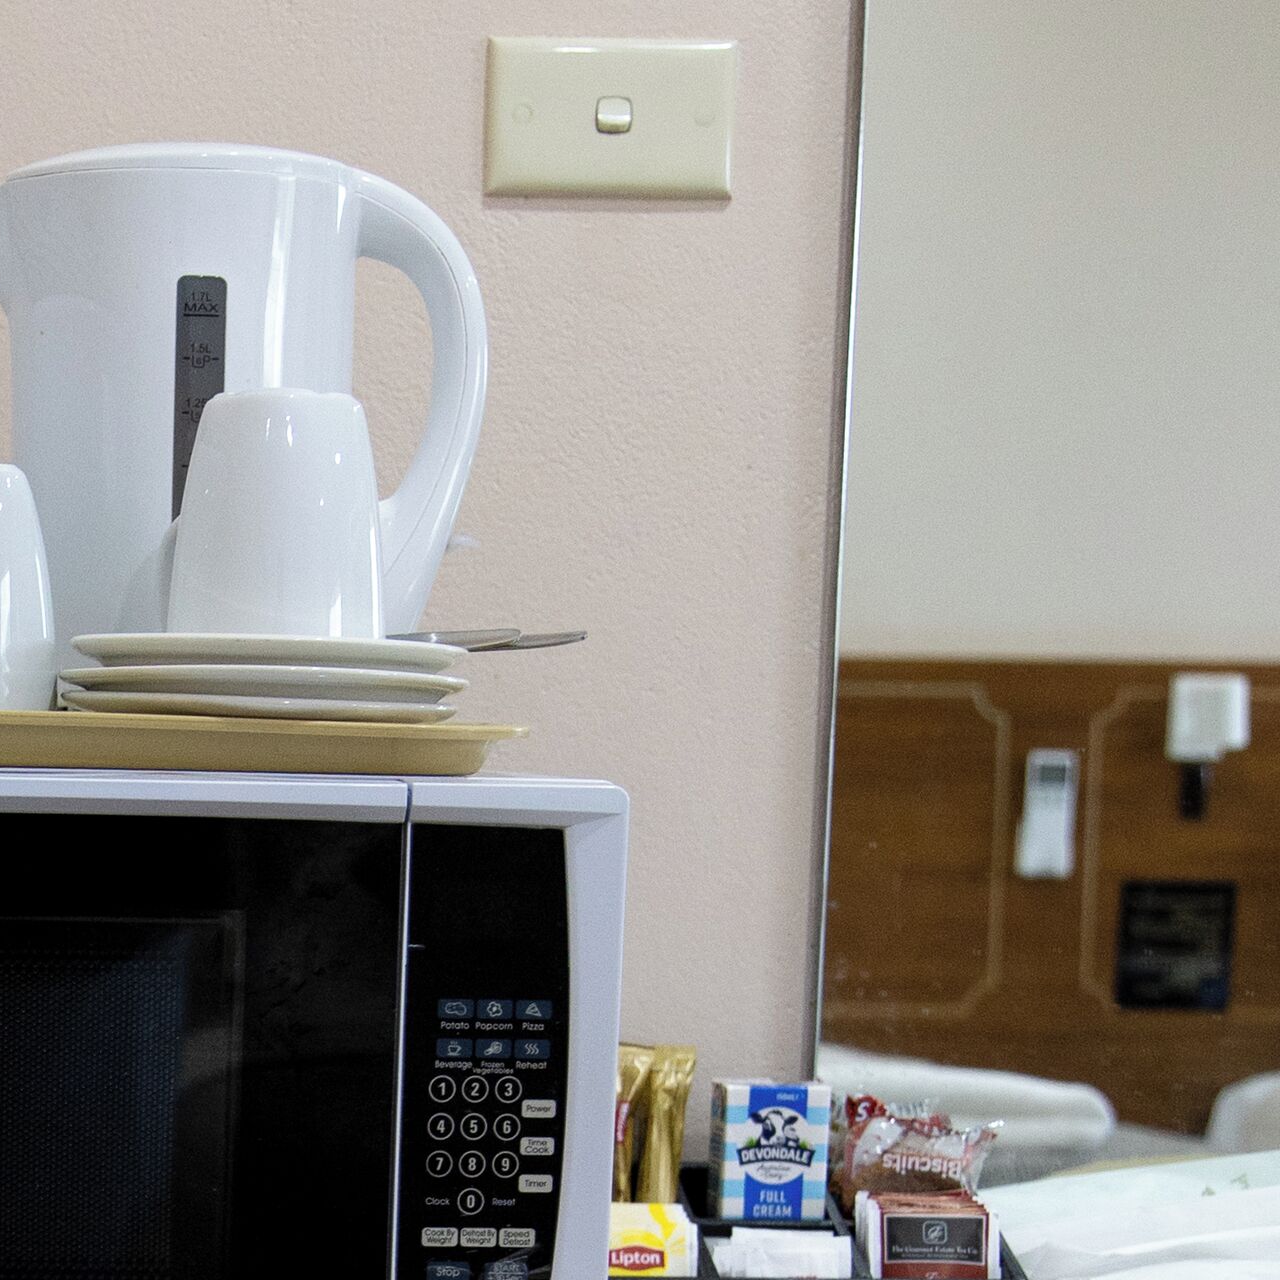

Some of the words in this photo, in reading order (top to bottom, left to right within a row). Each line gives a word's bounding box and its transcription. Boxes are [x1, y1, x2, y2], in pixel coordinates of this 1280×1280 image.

[191, 291, 212, 302] 1.7L
[183, 303, 219, 313] MAX
[190, 343, 211, 354] 1.5L
[440, 1021, 470, 1030] Potato
[475, 1021, 513, 1031] Popcorn
[522, 1022, 544, 1031] Pizza
[434, 1060, 473, 1070] Beverage
[481, 1060, 505, 1068] Frozen
[515, 1060, 547, 1070] Reheat
[438, 1082, 446, 1096] 1
[471, 1082, 479, 1096] 2
[504, 1083, 513, 1097] 3
[526, 1104, 551, 1113] Power
[436, 1120, 445, 1133] 4
[470, 1120, 478, 1133] 5
[503, 1120, 511, 1134] 6
[741, 1147, 810, 1163] DEVONDALE
[436, 1157, 444, 1171] 7
[468, 1157, 477, 1171] 8
[501, 1158, 510, 1172] 9
[883, 1152, 962, 1178] Biscuits
[425, 1197, 450, 1205] Clock
[466, 1194, 475, 1209] 0
[492, 1197, 516, 1206] Reset
[759, 1190, 786, 1204] FULL
[753, 1204, 792, 1218] CREAM
[424, 1228, 446, 1236] Cook
[446, 1229, 456, 1238] By
[462, 1229, 487, 1237] Defrost
[487, 1230, 496, 1238] By
[503, 1230, 530, 1239] Speed
[427, 1237, 452, 1245] Weight
[466, 1237, 492, 1245] Weight
[503, 1238, 531, 1246] Defrost
[611, 1251, 661, 1267] Lipton
[436, 1266, 461, 1278] Stop
